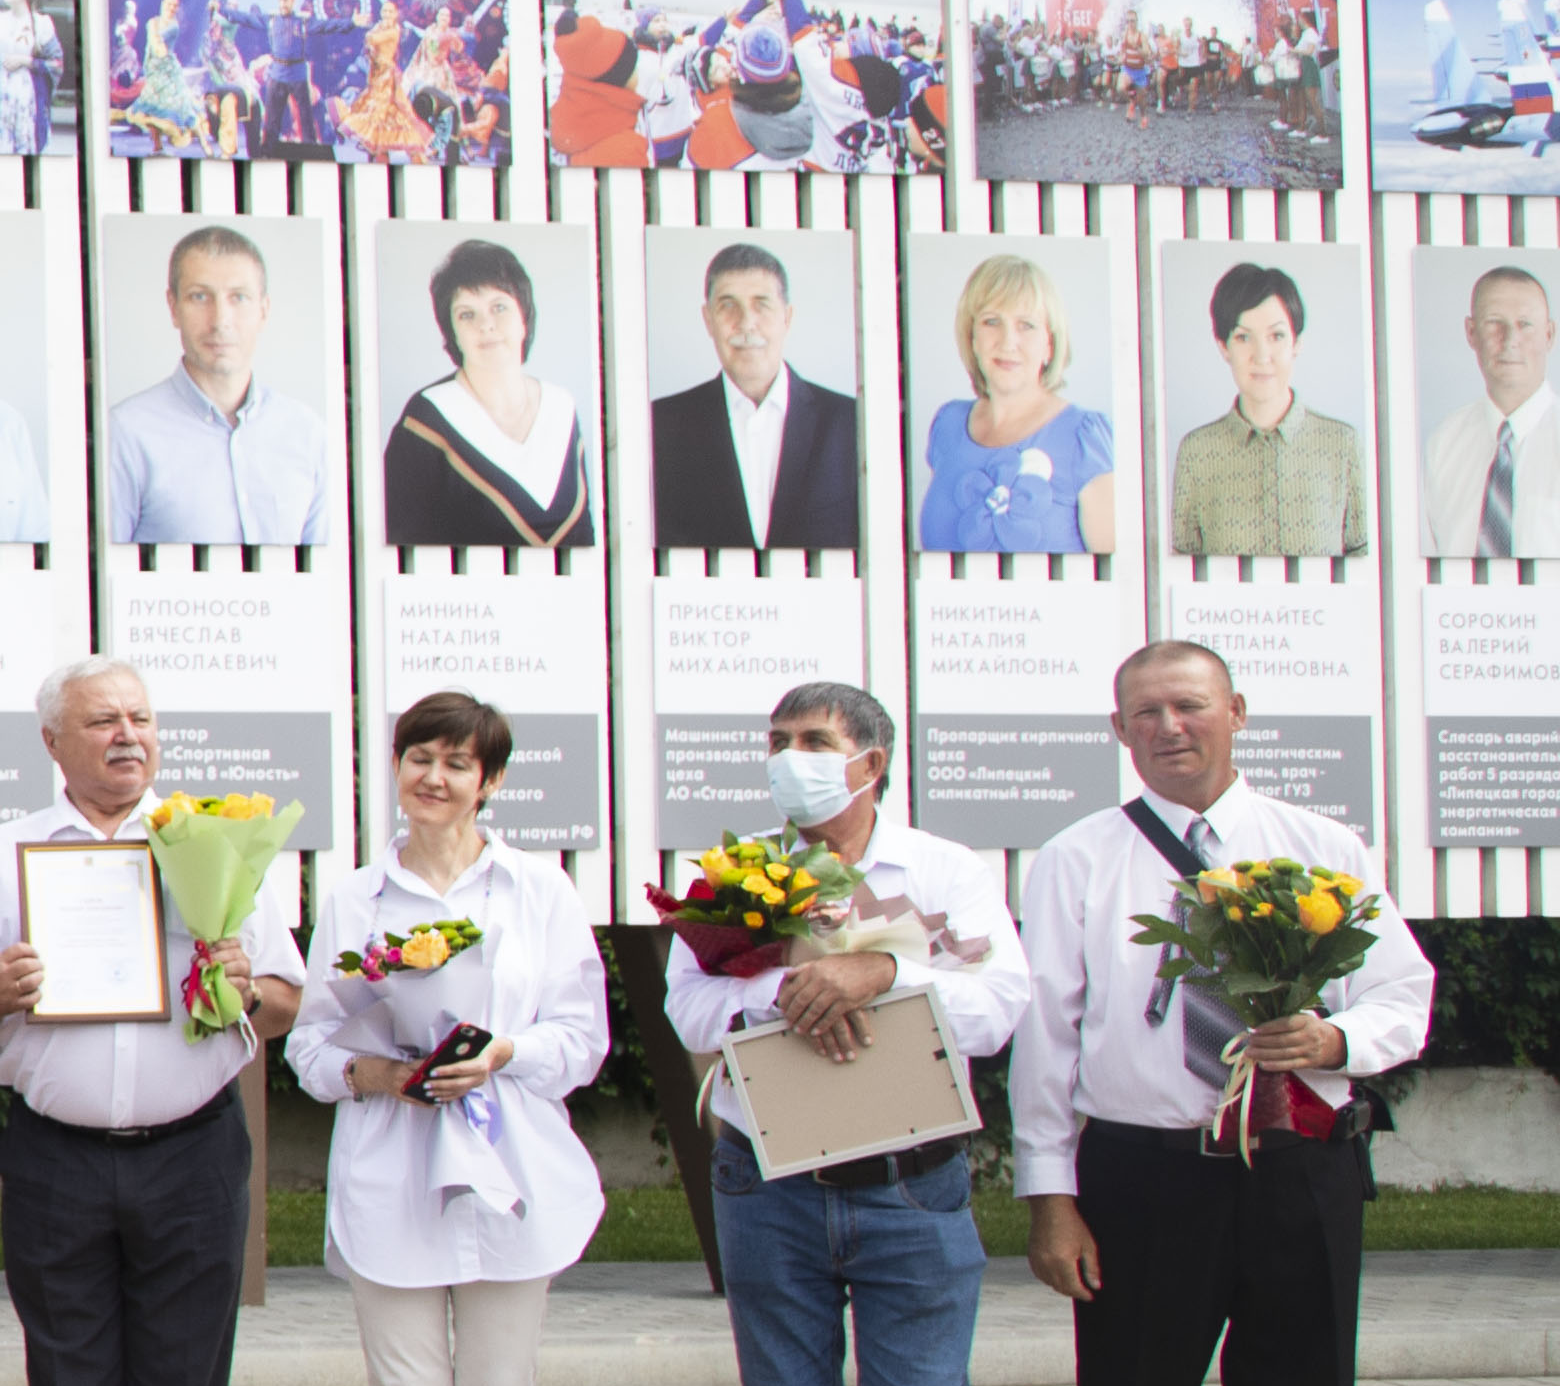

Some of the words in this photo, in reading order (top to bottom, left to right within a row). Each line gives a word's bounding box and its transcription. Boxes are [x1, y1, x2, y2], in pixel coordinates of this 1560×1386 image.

[129, 600, 271, 616] ЛУПОНОСОВ
[401, 604, 493, 619] МИНИНА
[669, 606, 778, 621] ПРИСЕКИН
[931, 607, 1041, 622] НИКИТИНА
[1185, 606, 1324, 625] СИМОНАЙТЕС
[1439, 614, 1536, 630] СОРОКИН
[130, 627, 241, 643] ВЯЧЕСЛАВ
[401, 631, 501, 646] НАТАЛИЯ
[670, 632, 750, 647] ВИКТОР
[931, 633, 1025, 648] НАТАЛИЯ
[1187, 635, 1290, 651] СВЕТЛАНА
[1439, 635, 1529, 654] ВАЛЕРИЙ
[130, 654, 277, 670] НИКОЛАЕВИЧ
[401, 656, 547, 673] НИКОЛАЕВНА
[669, 655, 819, 674] МИХАЙЛОВИЧ
[930, 655, 1079, 675] МИХАЙЛОВНА
[1228, 661, 1349, 676] ЕНТИНОВНА
[666, 729, 747, 744] Машинист
[928, 729, 1017, 744] Пропарщик
[1022, 731, 1108, 745] кирпичного
[1438, 731, 1501, 746] Слесарь
[164, 746, 270, 762] «Спортивная
[928, 750, 965, 764] цеха
[185, 767, 203, 780] №
[207, 767, 217, 780] 8
[221, 767, 299, 781] «Юность»
[666, 769, 704, 783] цеха
[928, 767, 965, 781] ООО
[969, 767, 1050, 782] «Липецкий
[1282, 767, 1316, 782] врач
[1439, 768, 1482, 783] работ
[1487, 768, 1495, 781] 5
[666, 786, 689, 801] АО
[928, 786, 1018, 801] силикатный
[1022, 788, 1075, 802] завод»
[1285, 783, 1310, 798] ГУЗ
[1439, 786, 1517, 801] «Липецкая
[1439, 807, 1555, 821] энергетическая
[507, 827, 516, 838] и
[522, 827, 567, 841] науки
[572, 825, 593, 841] РФ
[1441, 825, 1519, 839] компания»
